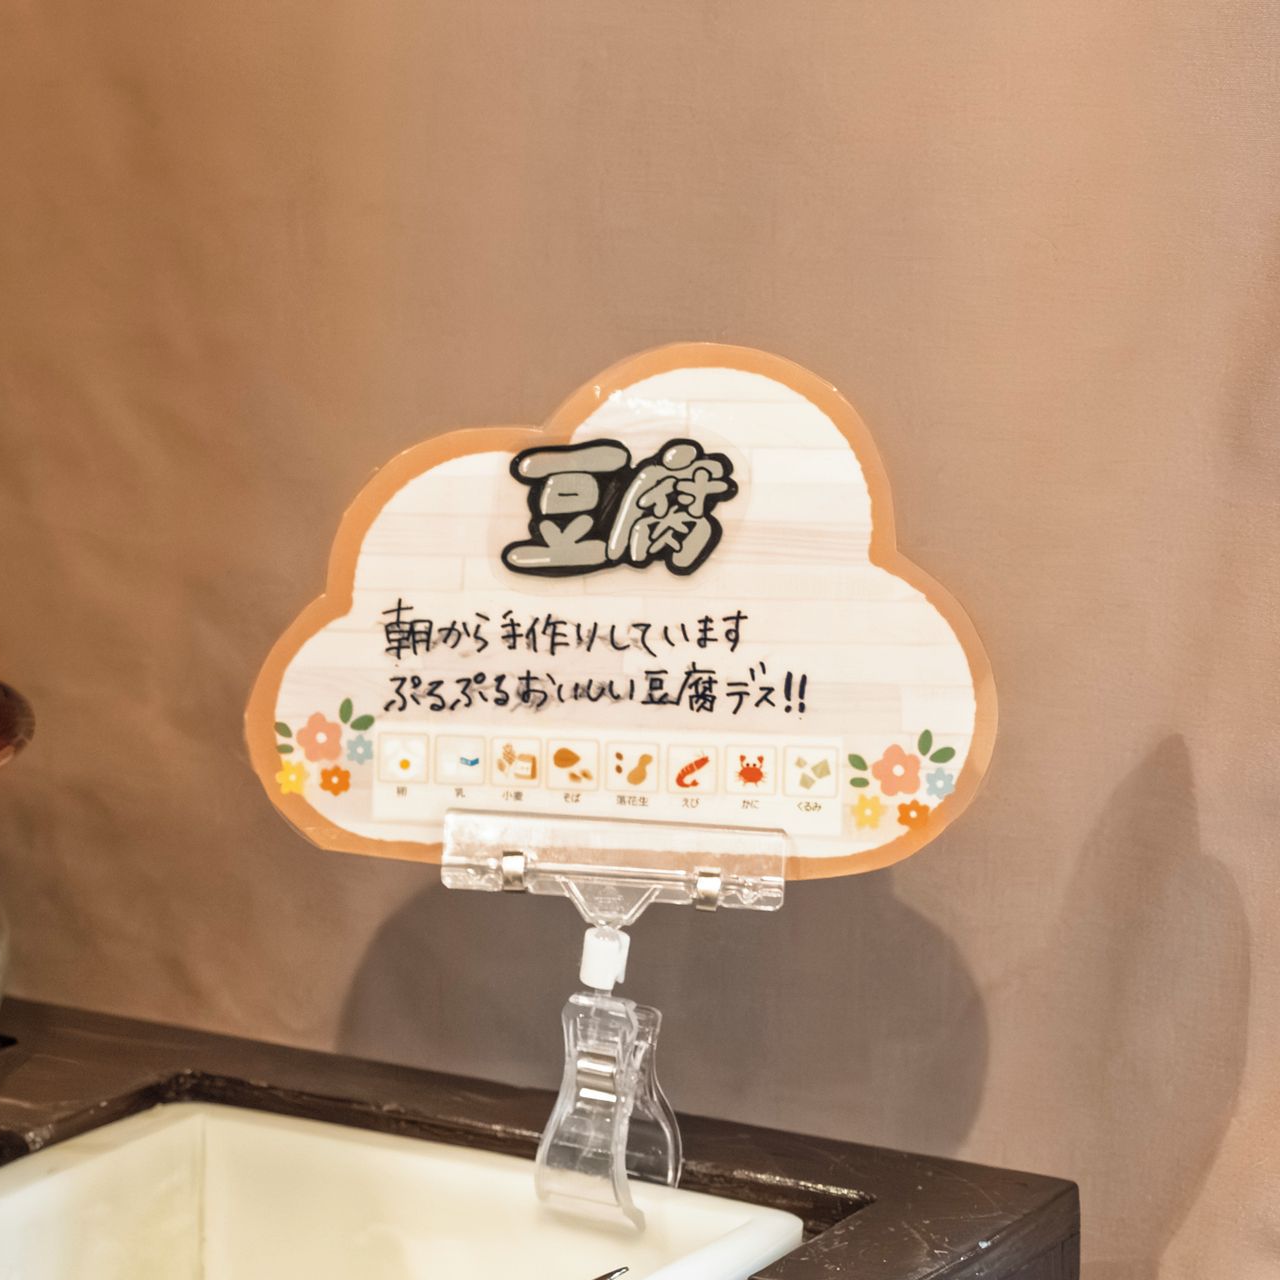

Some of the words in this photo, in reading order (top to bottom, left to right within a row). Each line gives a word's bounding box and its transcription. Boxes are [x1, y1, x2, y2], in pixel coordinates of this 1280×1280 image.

[501, 438, 739, 577] 豆腐
[383, 599, 748, 659] 朝から手作りしています
[796, 800, 823, 813] くるみ
